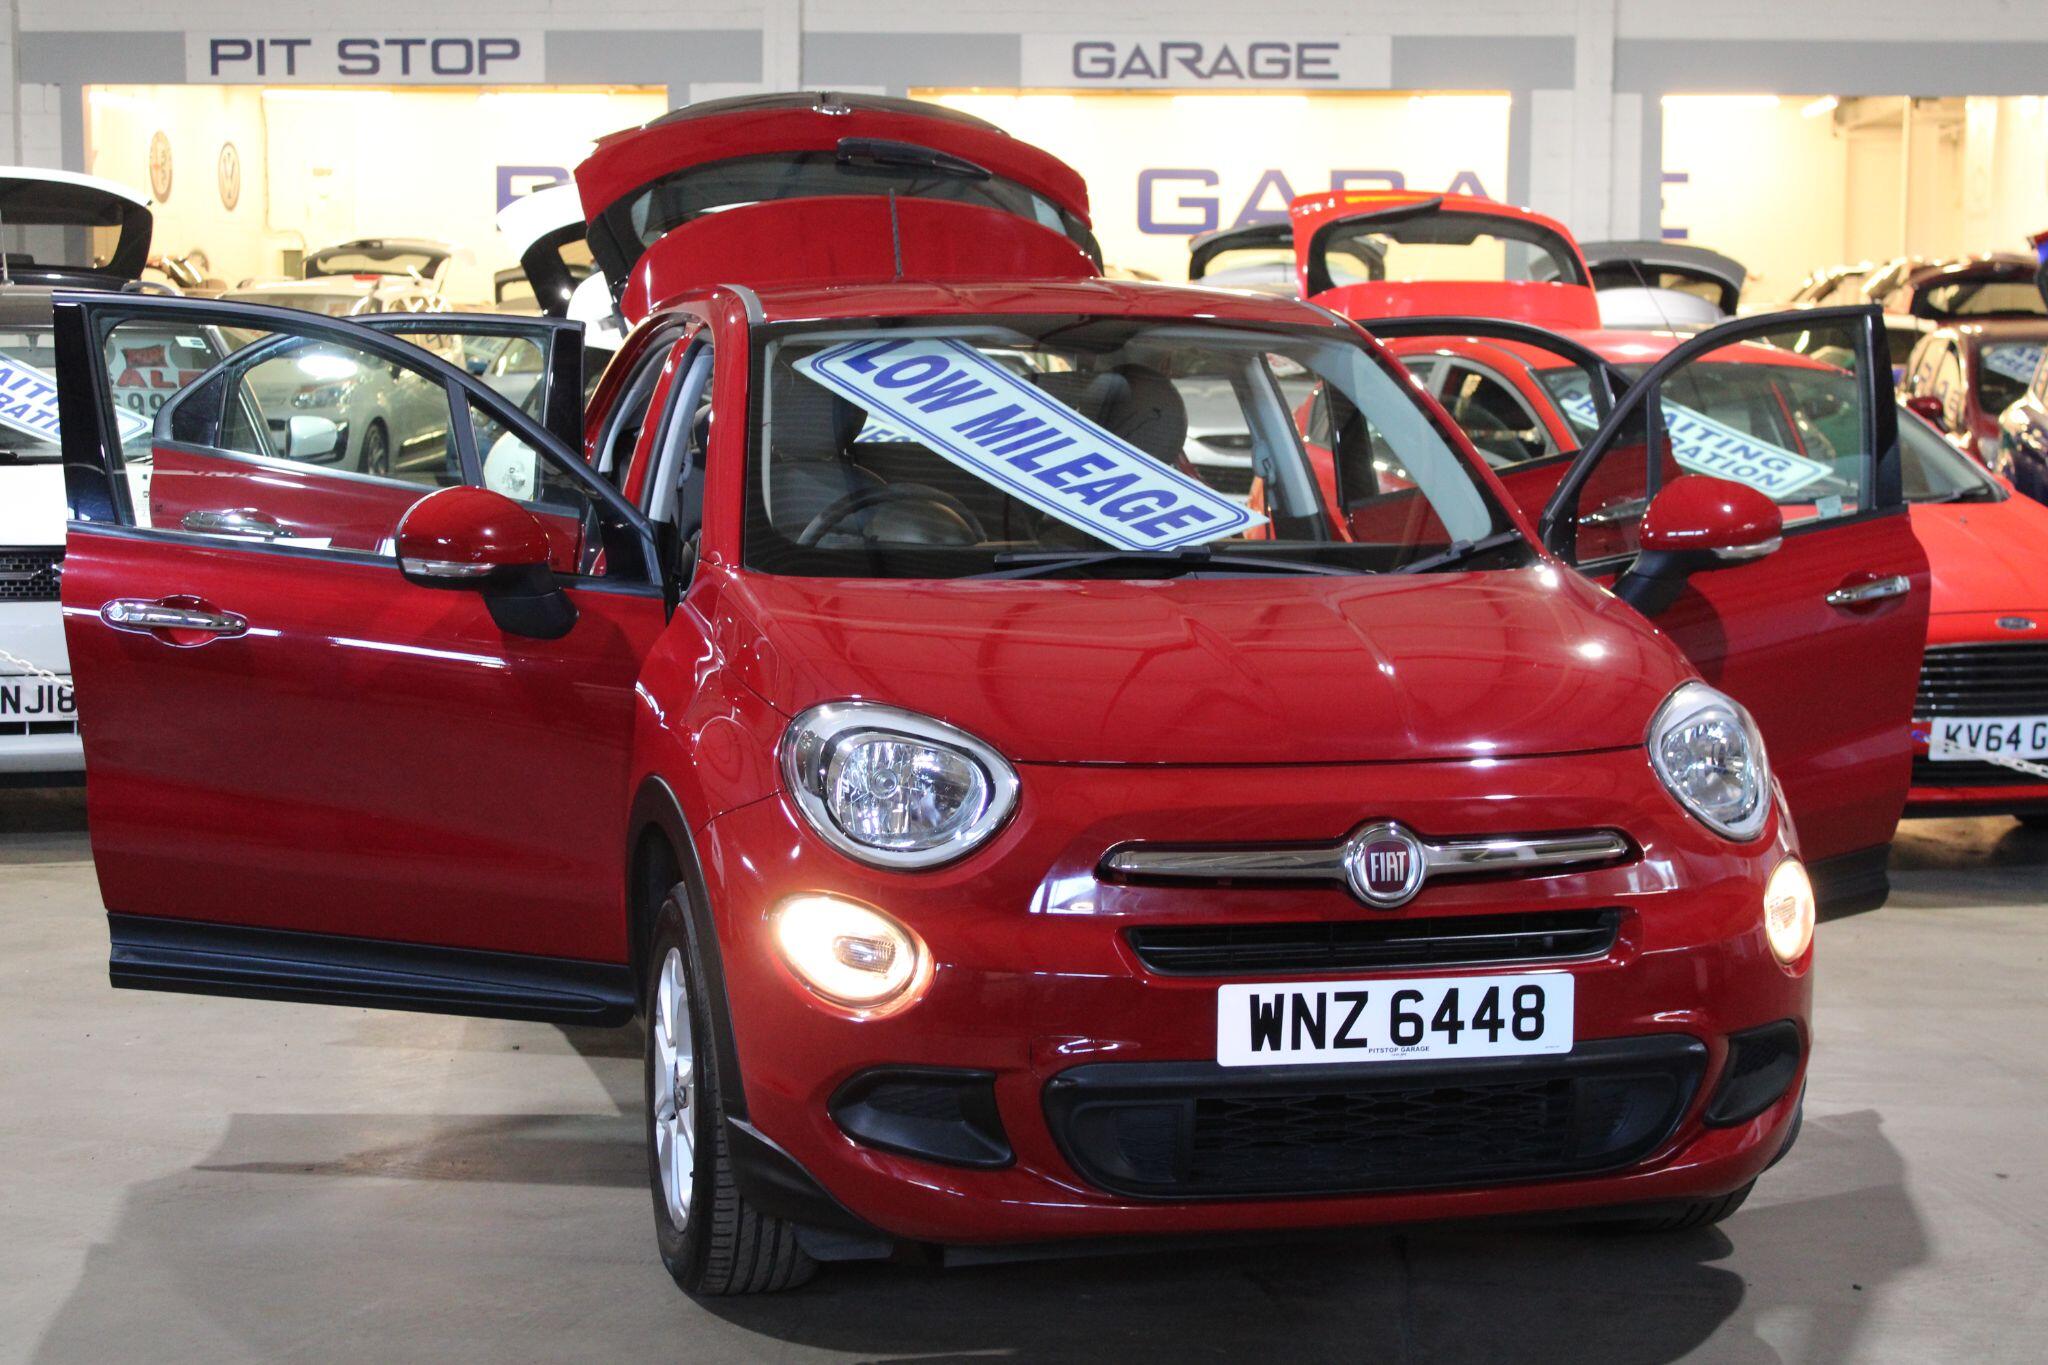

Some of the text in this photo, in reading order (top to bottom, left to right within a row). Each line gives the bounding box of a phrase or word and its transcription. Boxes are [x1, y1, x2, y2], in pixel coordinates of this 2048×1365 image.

[210, 38, 521, 76] PIT STOP
[1072, 41, 1340, 80] GARAGE
[841, 337, 1218, 539] LOW MILEAGE
[1663, 410, 1792, 473] AITING
[1370, 851, 1407, 882] FIAT
[1249, 984, 1546, 1052] WNZ 6448
[1368, 1045, 1430, 1054] PITSTOP GARAGE
